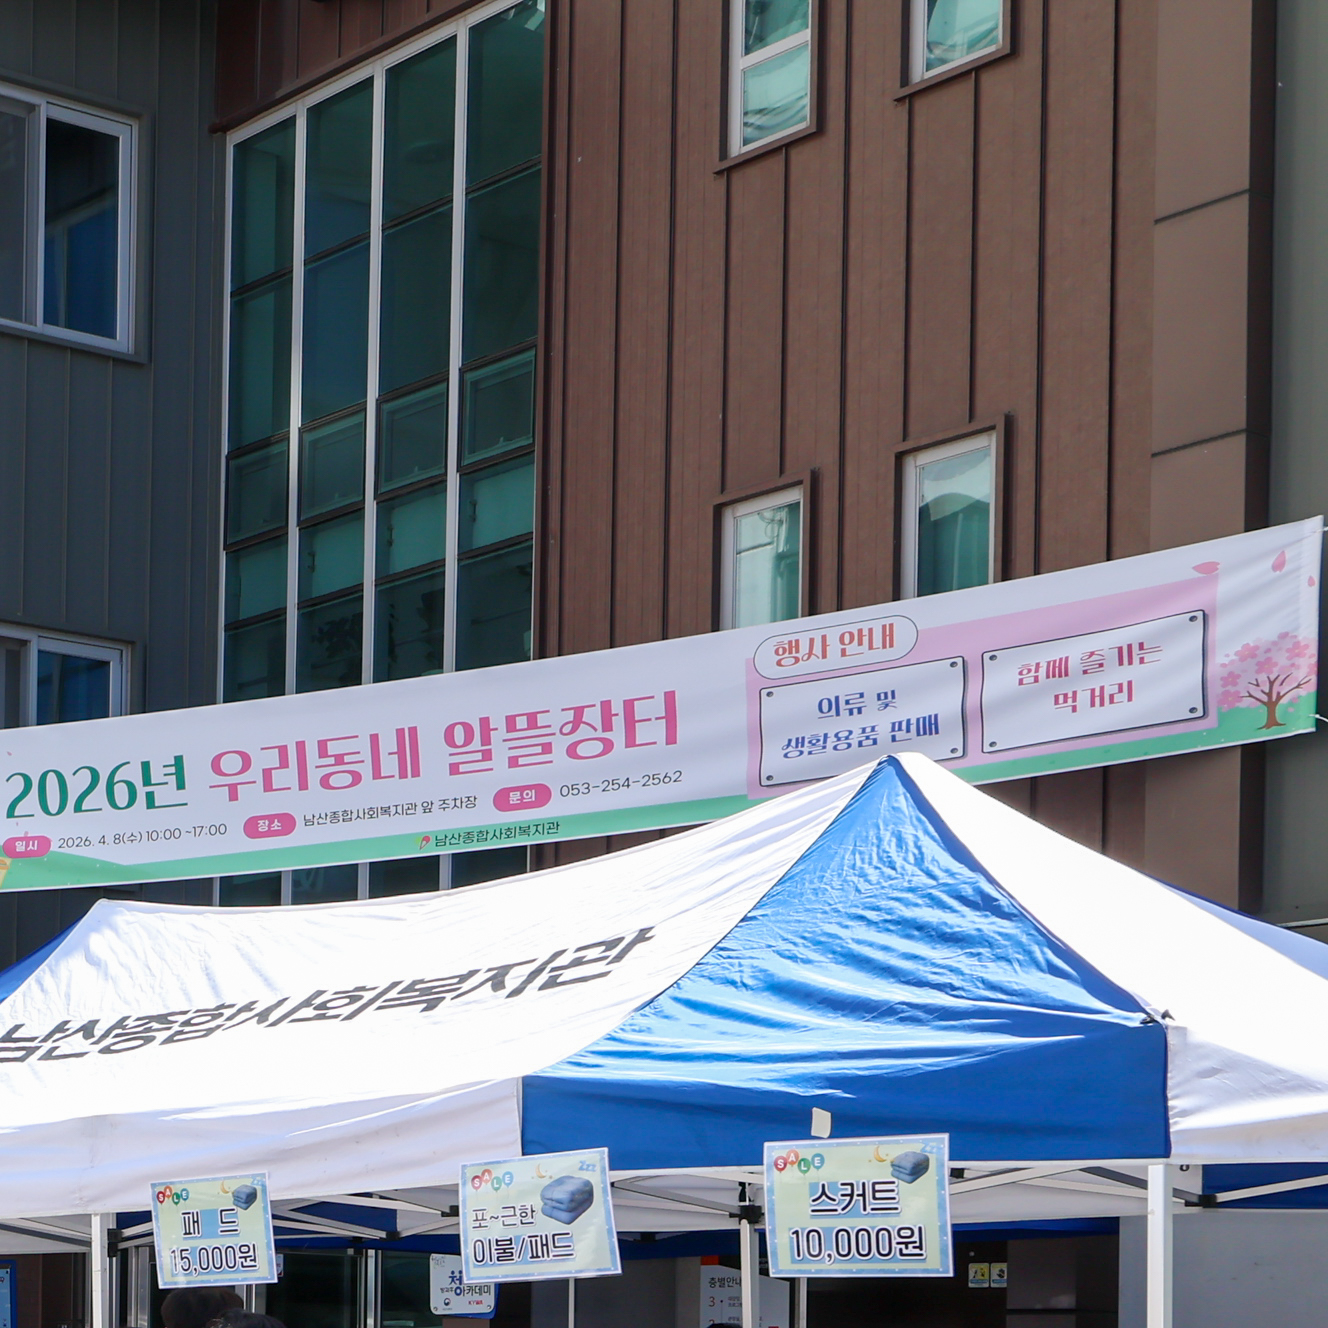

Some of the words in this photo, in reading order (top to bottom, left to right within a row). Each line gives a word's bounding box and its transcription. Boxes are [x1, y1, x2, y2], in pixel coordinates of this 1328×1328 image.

[773, 636, 831, 669] 행사
[838, 622, 896, 658] 안내
[1017, 663, 1072, 688] 함께
[1080, 641, 1164, 677] 즐기는
[816, 691, 867, 721] 의류
[875, 689, 899, 712] 및
[1053, 680, 1135, 714] 먹거리
[781, 723, 880, 761] 생활용품
[889, 713, 942, 745] 판매
[5, 754, 189, 820] 2026년
[208, 725, 423, 803] 우리동네
[442, 690, 680, 778] 알뜰장터
[507, 788, 538, 806] 문의
[558, 770, 684, 799] 053-254-2562
[303, 803, 418, 828] 남산종합사회복지관
[421, 800, 435, 814] 앞
[438, 794, 478, 812] 주차장
[57, 834, 95, 849] 2026.
[99, 834, 109, 846] 4.
[113, 830, 143, 845] 8(수)
[146, 826, 182, 842] 10:00
[185, 822, 228, 839] ~17:00
[257, 818, 283, 834] 장소
[434, 822, 557, 847] 남산종합사회복지관
[15, 839, 39, 853] 일시
[774, 1150, 825, 1172] SALE
[157, 1186, 189, 1204] SALE
[471, 1170, 513, 1191] SALE
[810, 1180, 899, 1214] 스커트
[181, 1210, 201, 1236] 패
[219, 1208, 239, 1233] 드
[471, 1204, 535, 1229] 포~근한
[473, 1231, 575, 1263] 이불/패드
[791, 1225, 926, 1263] 10,000원
[170, 1243, 257, 1275] 15,000원
[708, 1296, 715, 1307] 3
